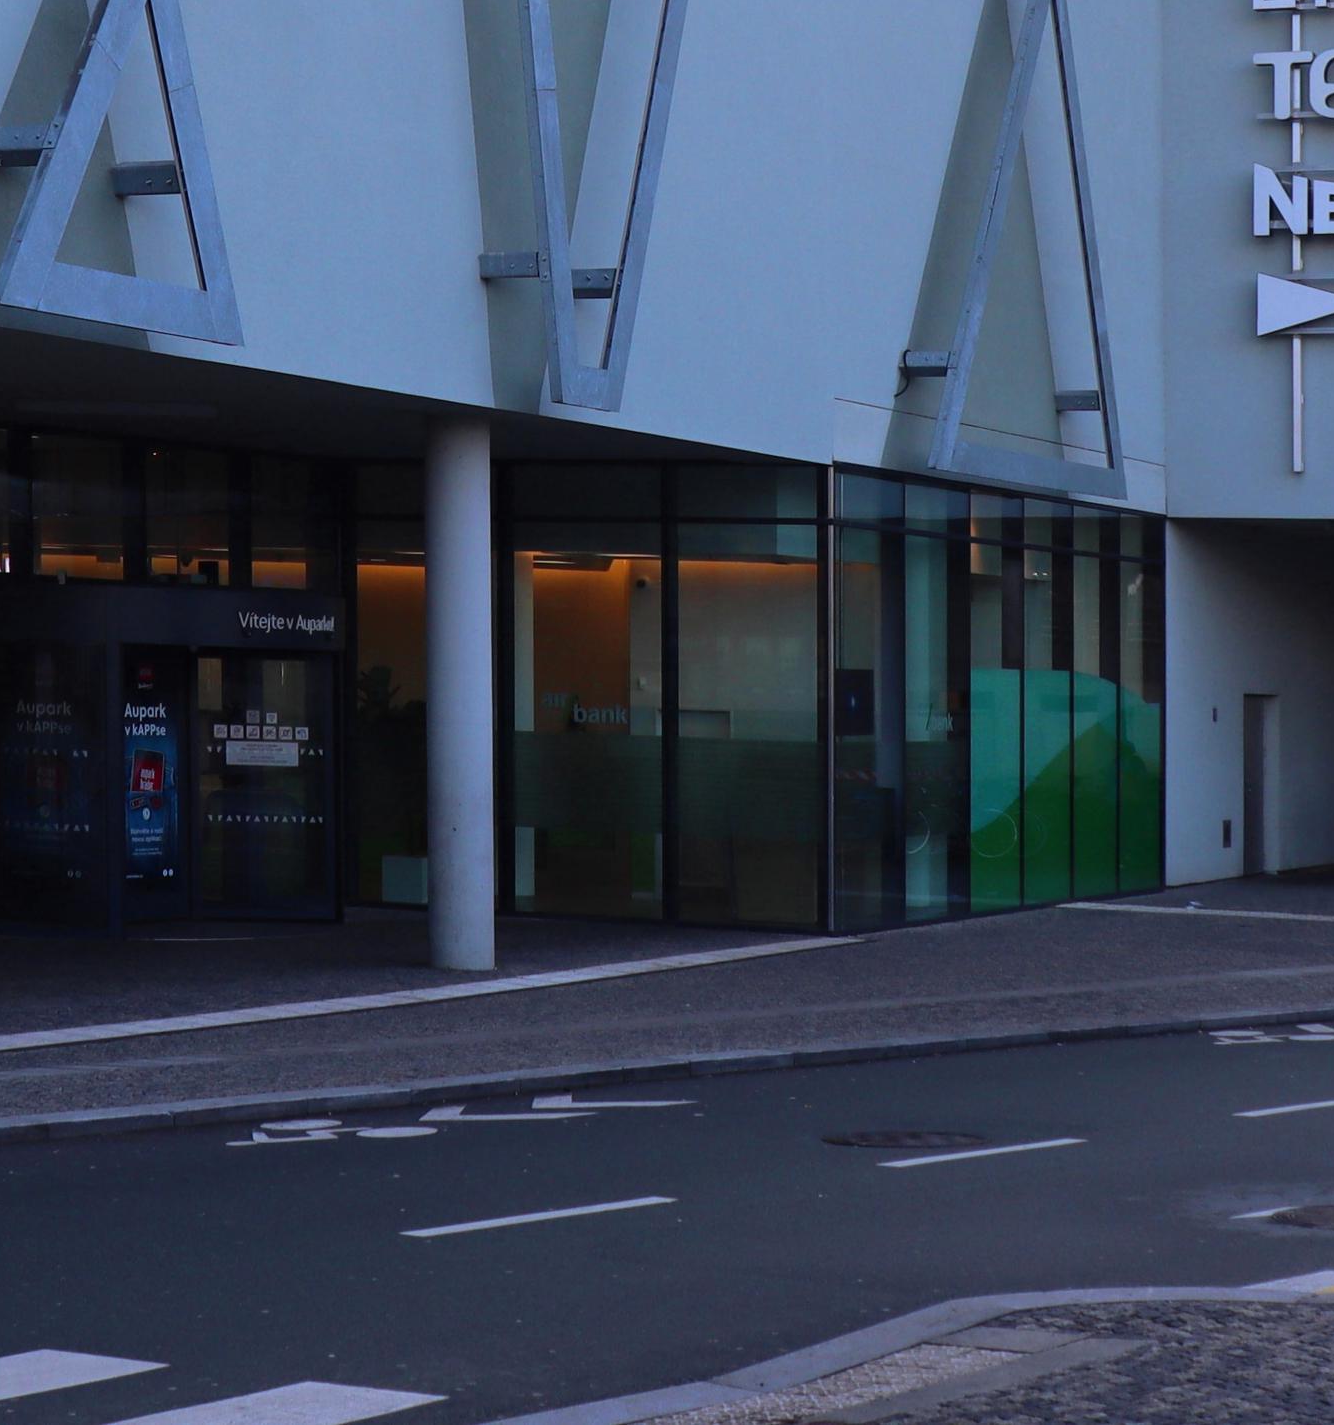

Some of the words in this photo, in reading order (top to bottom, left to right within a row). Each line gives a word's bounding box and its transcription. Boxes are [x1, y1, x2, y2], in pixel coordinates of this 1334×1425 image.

[237, 610, 285, 634] Vítejte
[286, 616, 294, 630] v
[124, 702, 167, 723] Aupark
[572, 702, 628, 725] bank
[124, 726, 131, 736] v
[132, 723, 167, 736] kAPPse
